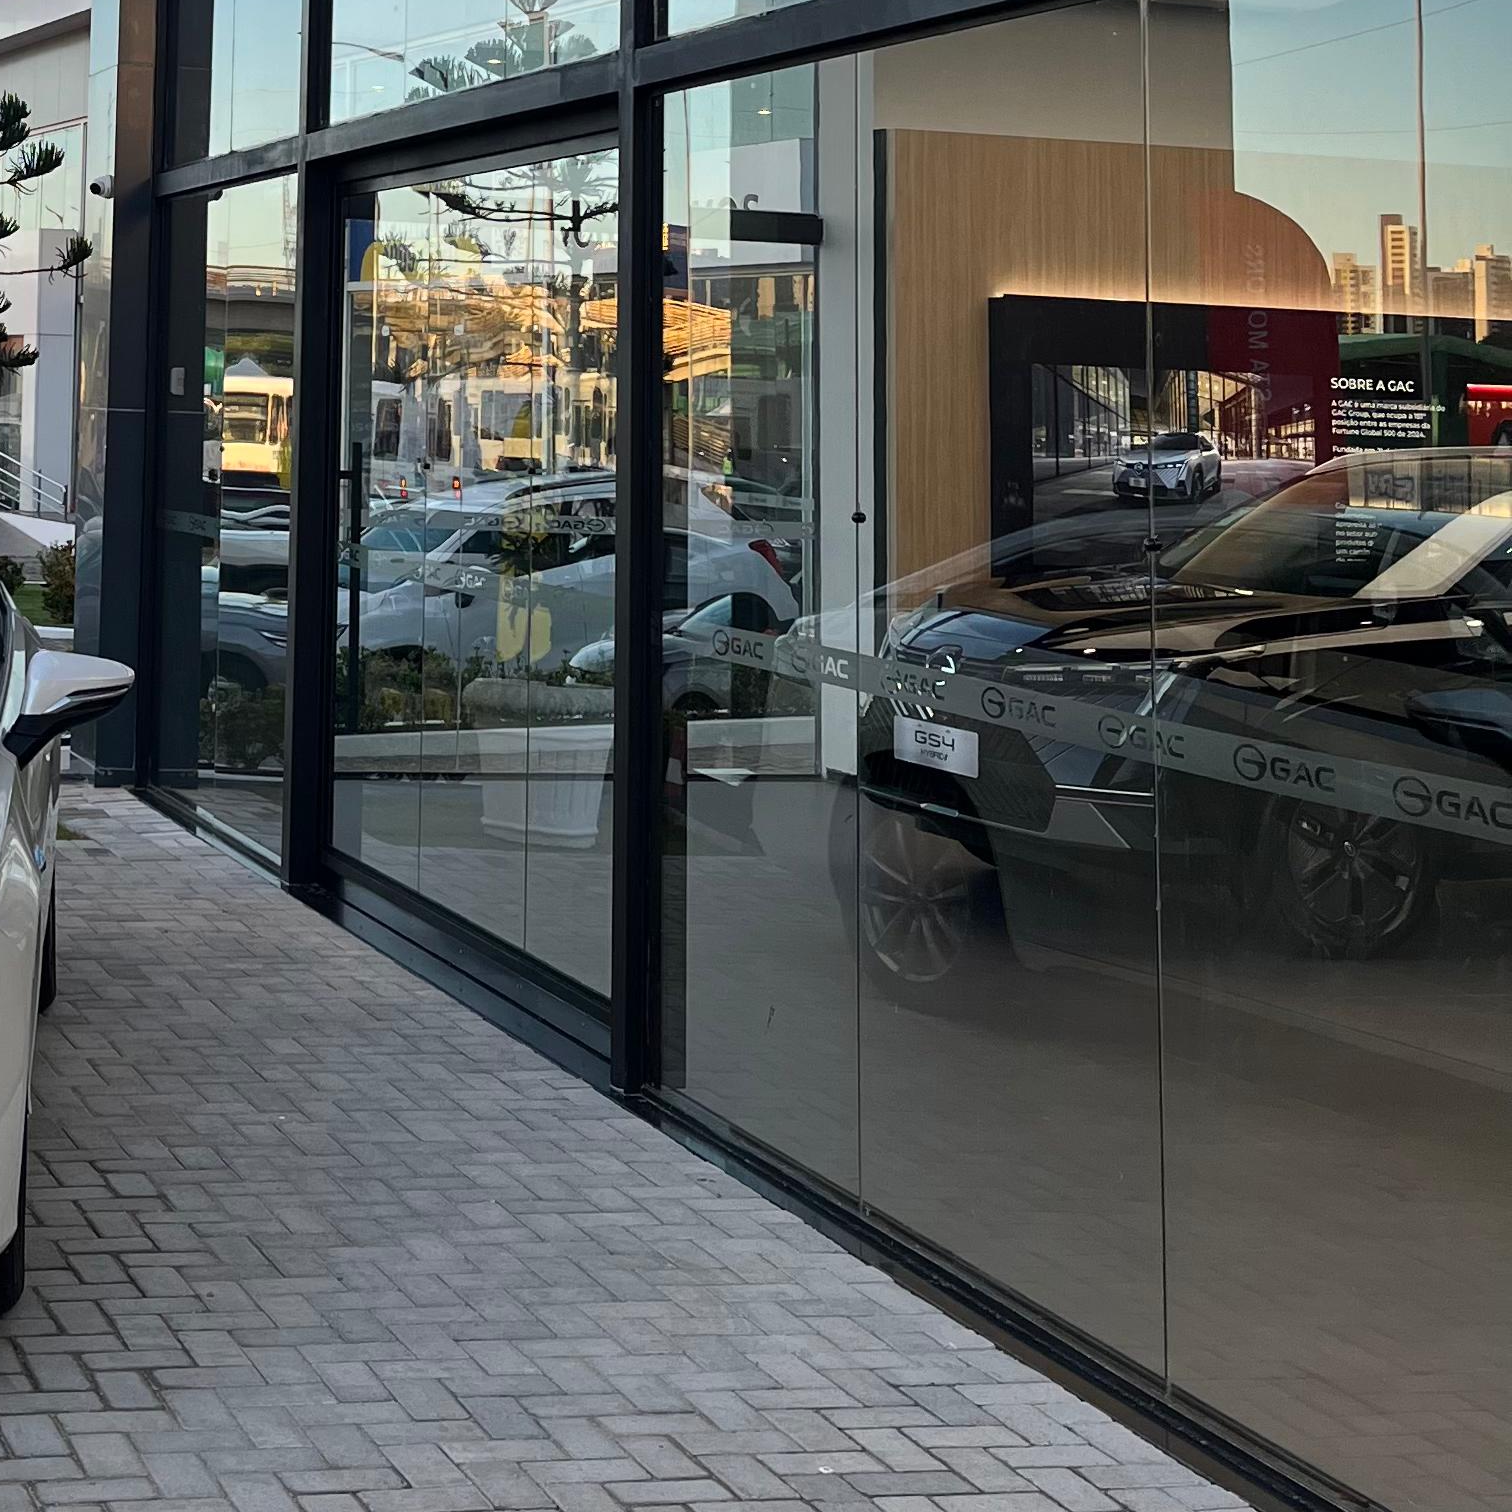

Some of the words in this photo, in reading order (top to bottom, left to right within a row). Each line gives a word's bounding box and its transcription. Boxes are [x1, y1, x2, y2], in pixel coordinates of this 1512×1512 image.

[1330, 377, 1374, 390] SOBRE
[1375, 380, 1385, 391] A
[1387, 380, 1415, 392] GAC
[730, 639, 763, 659] GAC
[1008, 697, 1057, 727] GAC
[915, 730, 955, 751] GS4
[1270, 757, 1336, 792] GAC
[1435, 791, 1512, 829] GAC
